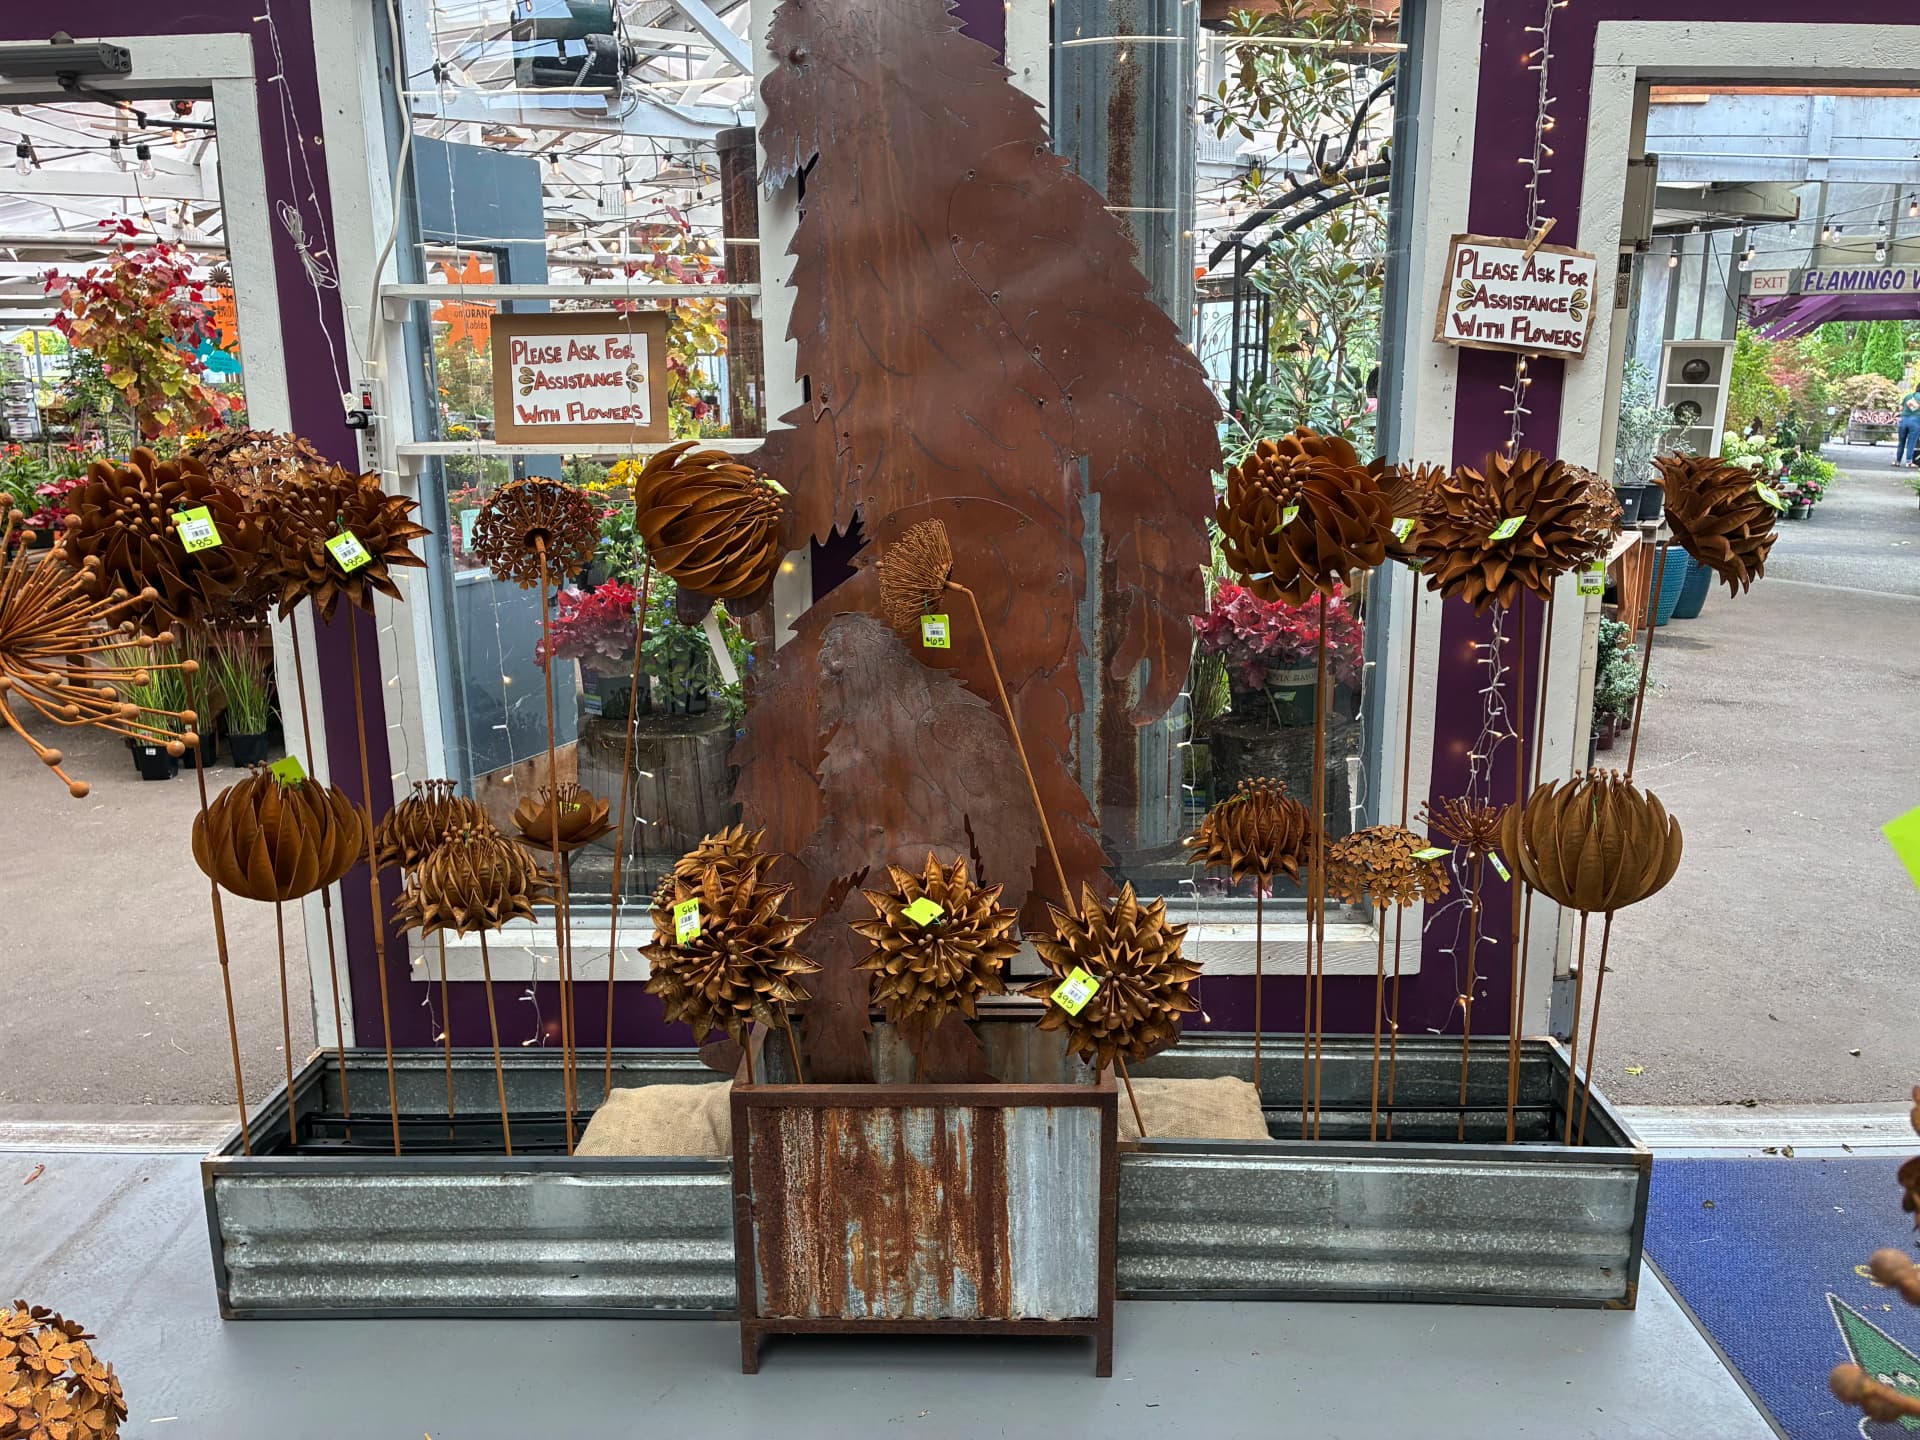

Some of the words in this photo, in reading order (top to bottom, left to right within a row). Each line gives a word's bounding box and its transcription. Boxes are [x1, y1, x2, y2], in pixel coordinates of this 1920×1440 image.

[1456, 249, 1519, 281] PLEASE
[1522, 255, 1556, 283] ASK
[1559, 259, 1589, 287] FOR
[1753, 276, 1787, 289] EXIT
[1804, 269, 1906, 291] FLAMINGO
[1471, 284, 1569, 312] ASSISTANCE
[465, 309, 496, 318] ORANG
[1452, 313, 1505, 338] WITH
[1511, 316, 1582, 348] FLOWERS
[511, 339, 563, 365] PLEASE
[567, 339, 600, 361] ASK
[605, 337, 635, 360] FOR
[534, 370, 624, 391] ASSISTANCE
[516, 404, 561, 424] WITH
[566, 401, 644, 422] FLOWERS
[189, 537, 213, 548] $85
[344, 555, 364, 567] $85
[1580, 585, 1601, 595] $65
[926, 637, 945, 646] $65
[1057, 992, 1074, 1009] $95
